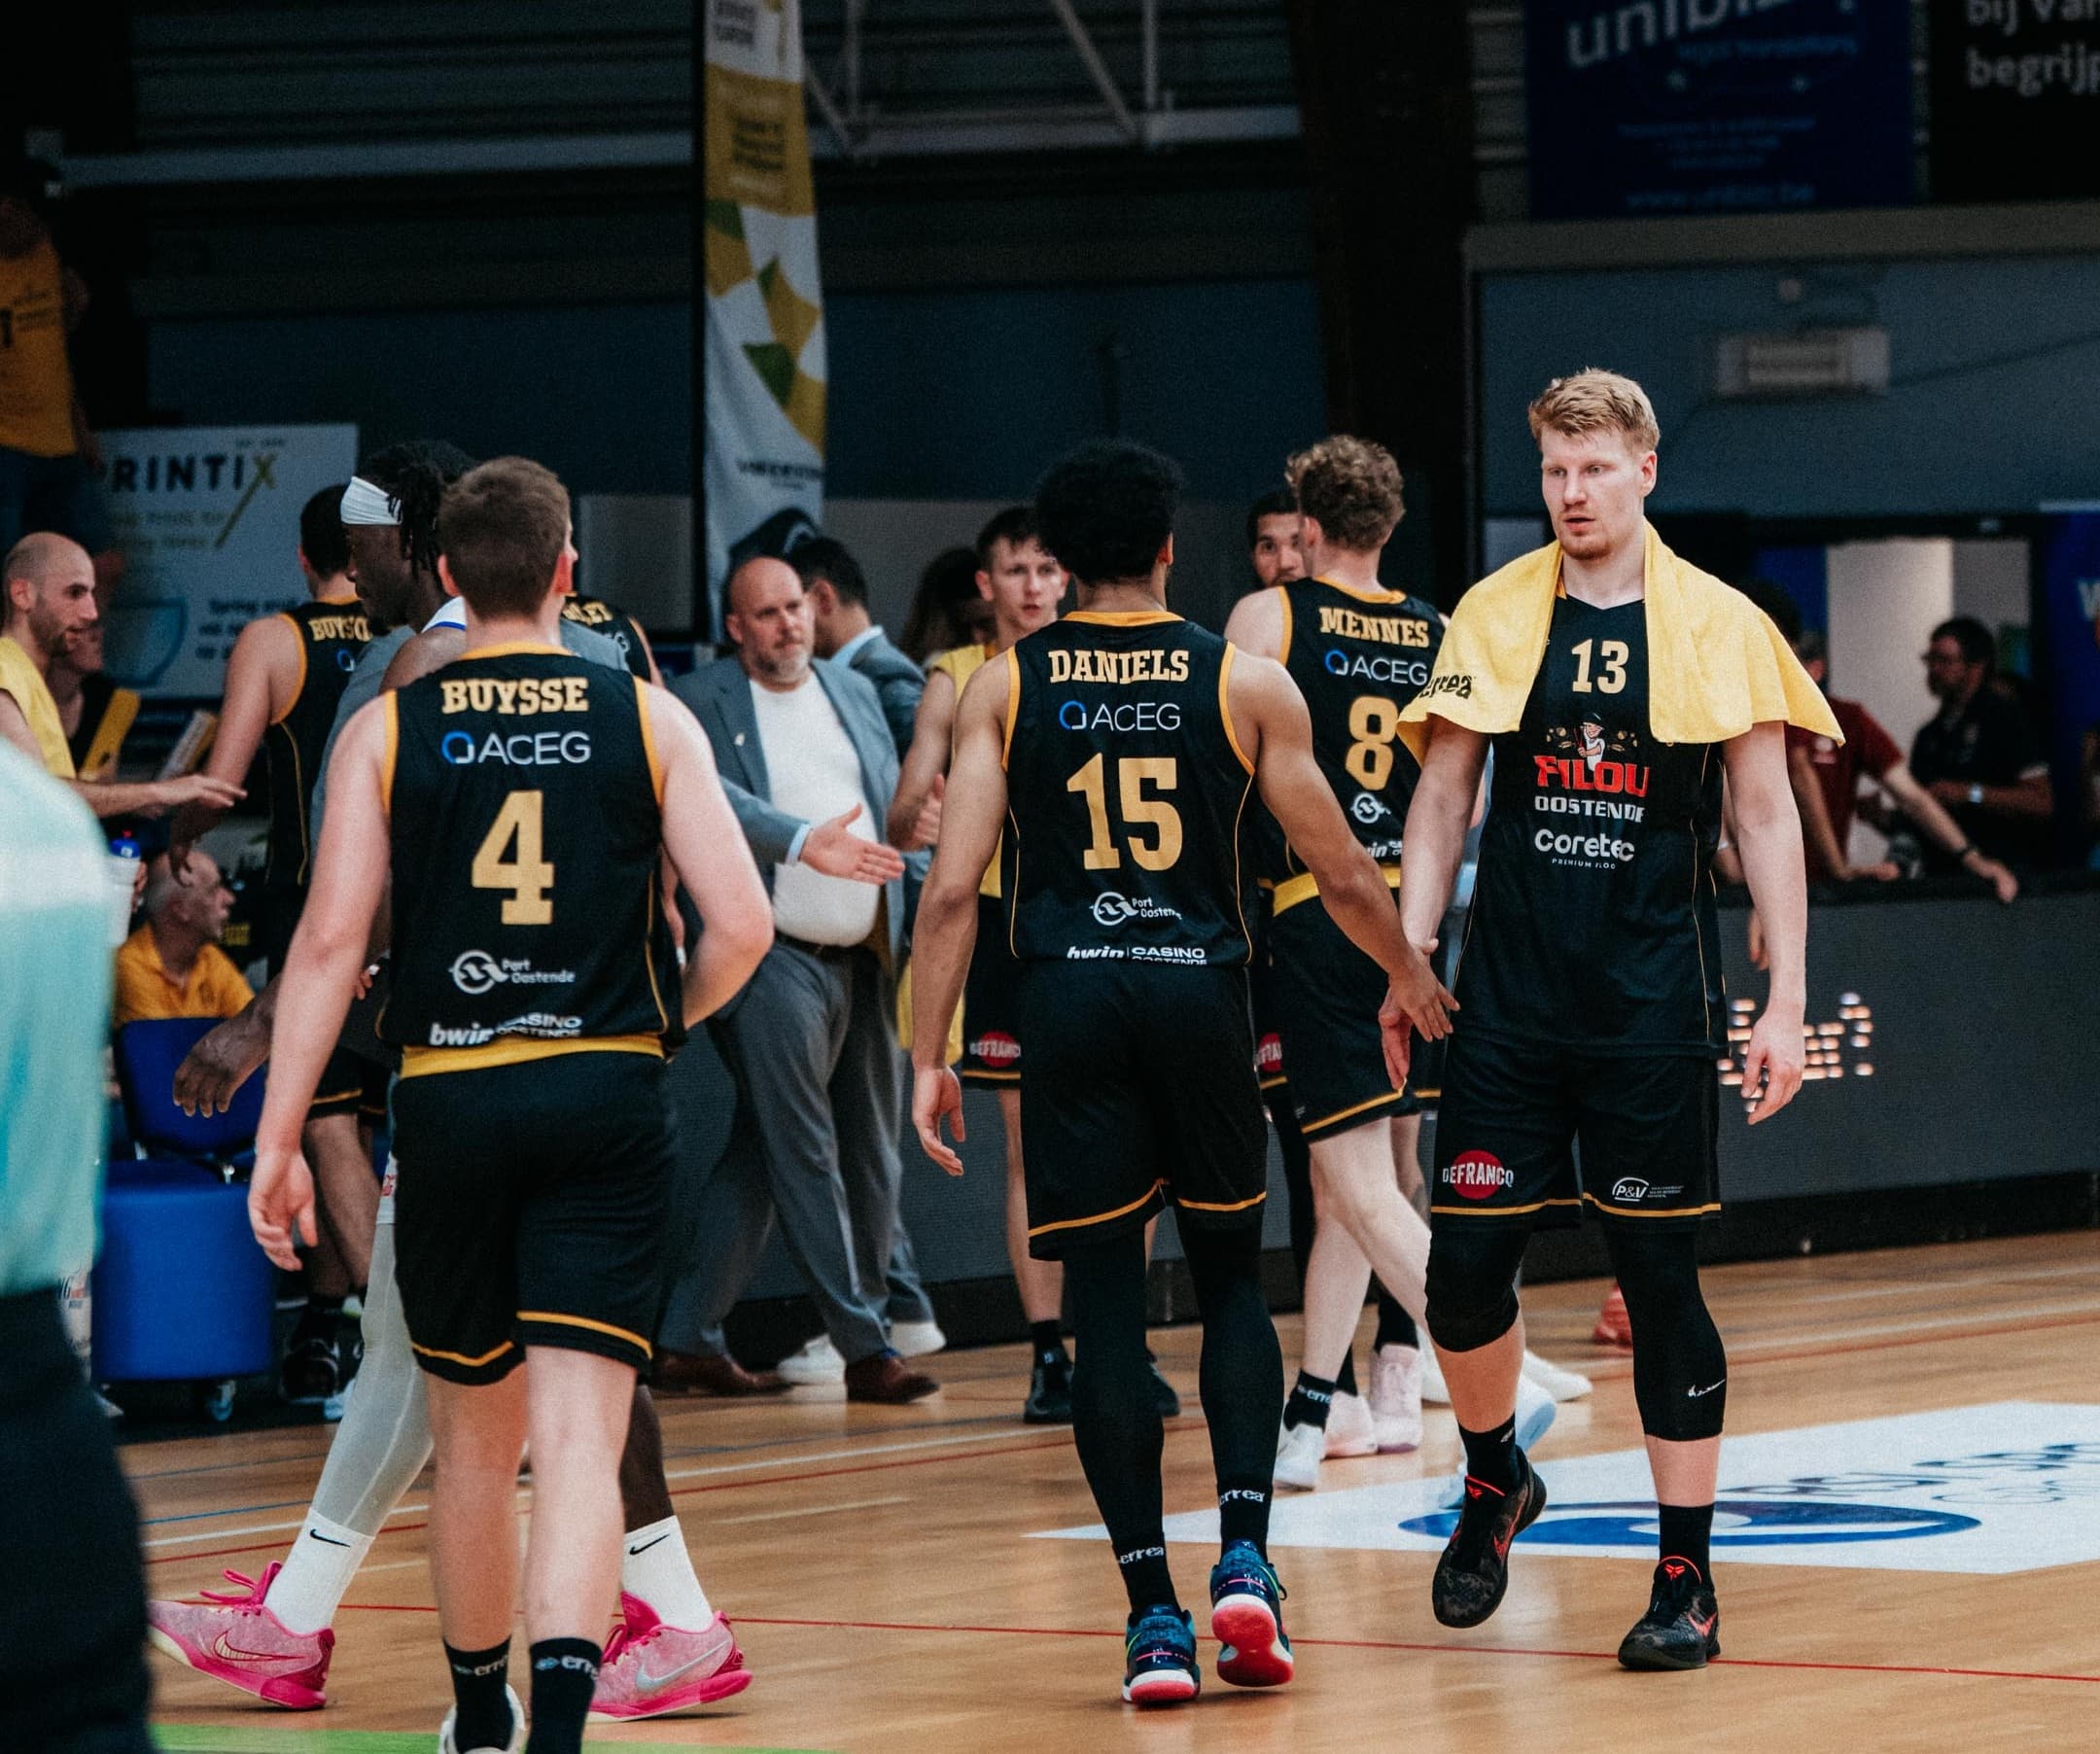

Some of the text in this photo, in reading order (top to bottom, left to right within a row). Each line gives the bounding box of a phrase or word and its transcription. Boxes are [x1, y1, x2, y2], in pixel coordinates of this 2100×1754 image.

[1319, 607, 1430, 648] MENNES
[1048, 649, 1190, 684] DANIELS
[1351, 656, 1428, 686] ACEG
[1571, 638, 1629, 694] 13
[440, 678, 589, 716] BUYSSE
[1091, 702, 1181, 732] ACEG
[477, 731, 591, 765] ACEG
[1345, 695, 1400, 791] 8
[1533, 755, 1650, 797] FILOU
[1066, 752, 1183, 871] 15
[472, 789, 555, 925] 4
[1132, 896, 1152, 909] Port
[502, 959, 530, 971] Port
[1132, 947, 1206, 959] CASINO
[510, 969, 576, 984] Oostende
[1616, 1185, 1648, 1199] P&V
